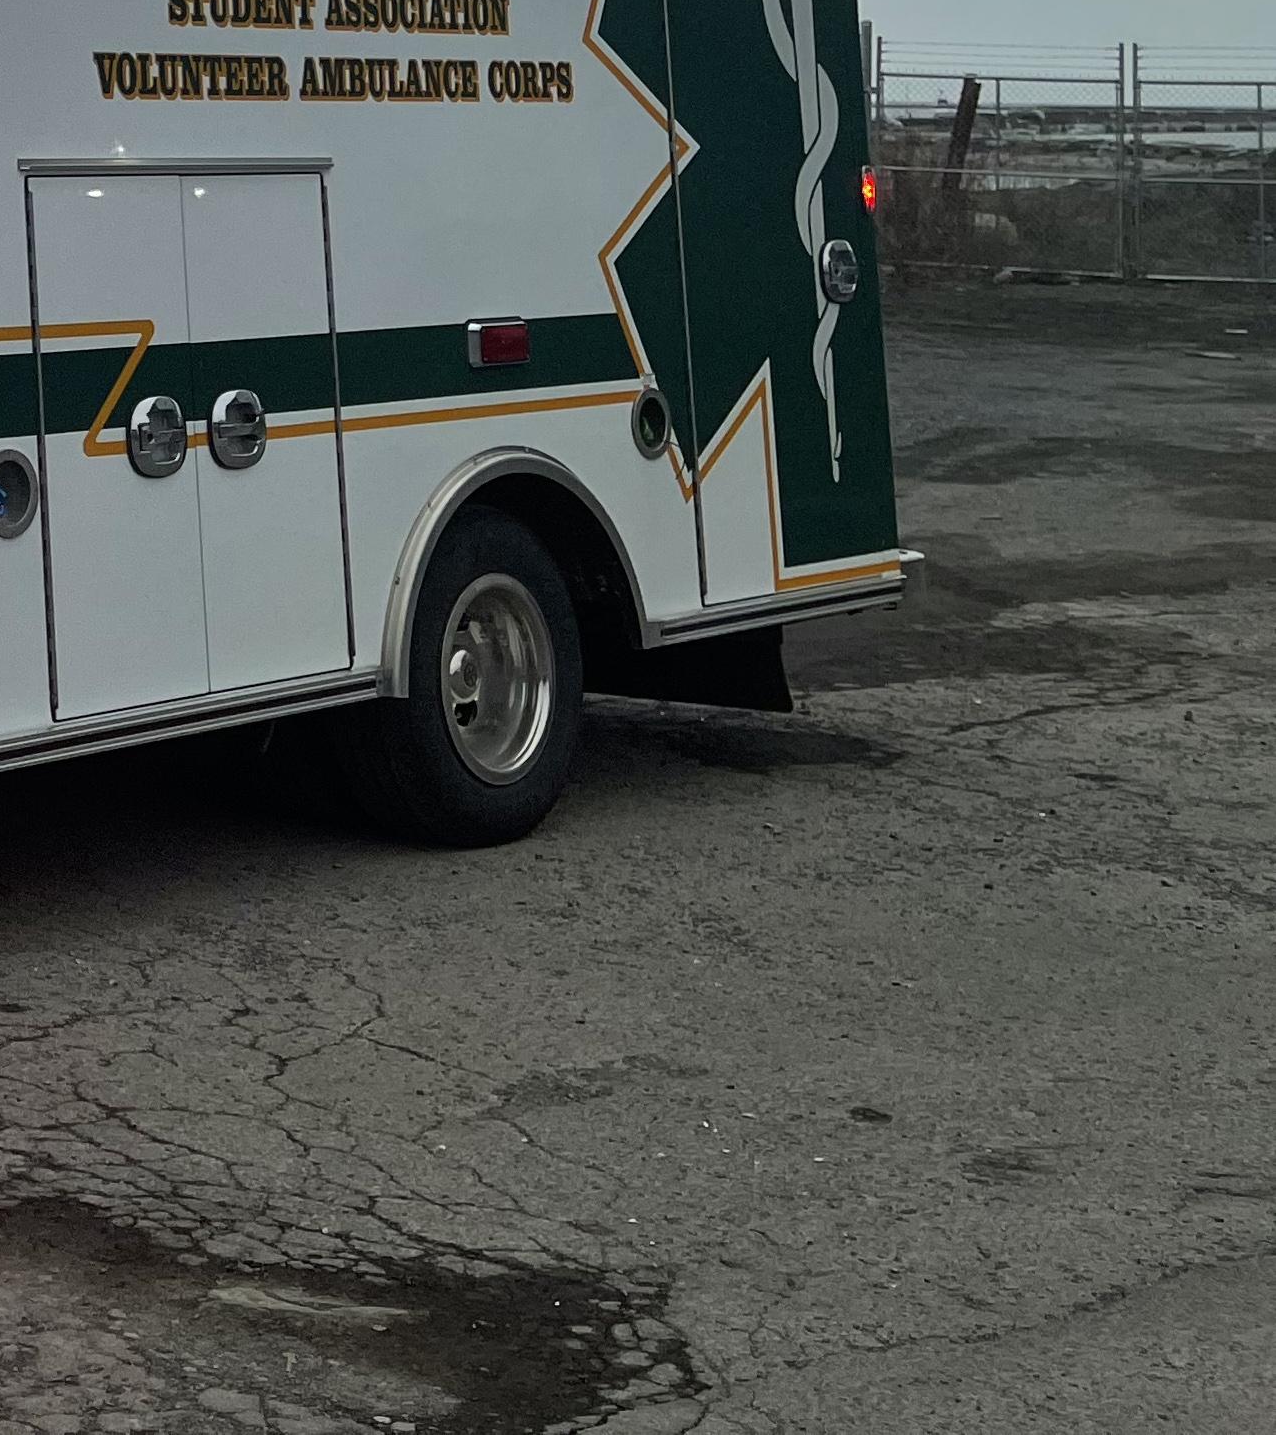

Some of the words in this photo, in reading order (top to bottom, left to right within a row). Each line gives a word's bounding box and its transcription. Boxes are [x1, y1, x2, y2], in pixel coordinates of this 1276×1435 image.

[92, 50, 290, 102] VOLUNTEER
[299, 56, 481, 103] AMBULANCE
[487, 59, 575, 103] CORPS
